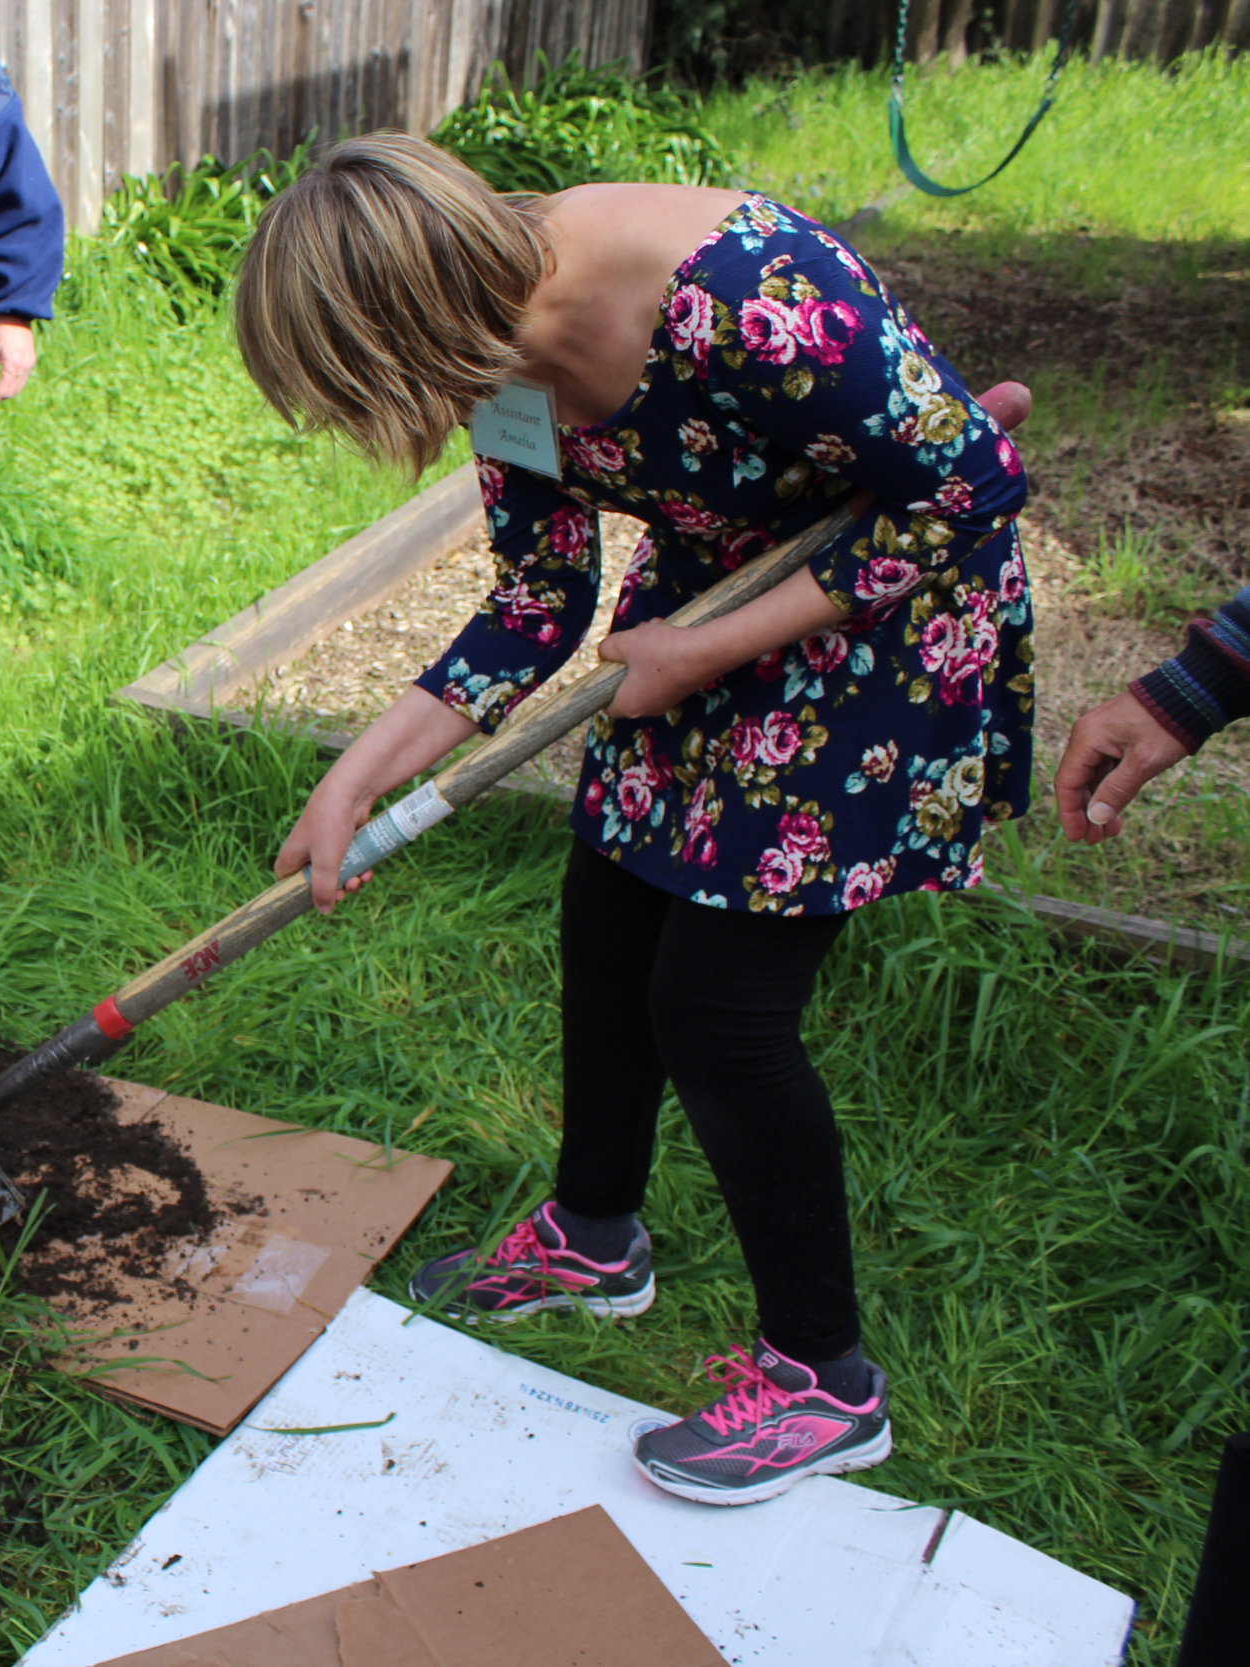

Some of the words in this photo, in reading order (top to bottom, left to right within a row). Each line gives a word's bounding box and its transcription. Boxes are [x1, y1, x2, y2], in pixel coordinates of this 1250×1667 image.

[491, 401, 542, 427] Assistant
[498, 428, 537, 450] Amelia
[180, 939, 221, 982] ACE
[777, 1432, 816, 1450] FILA
